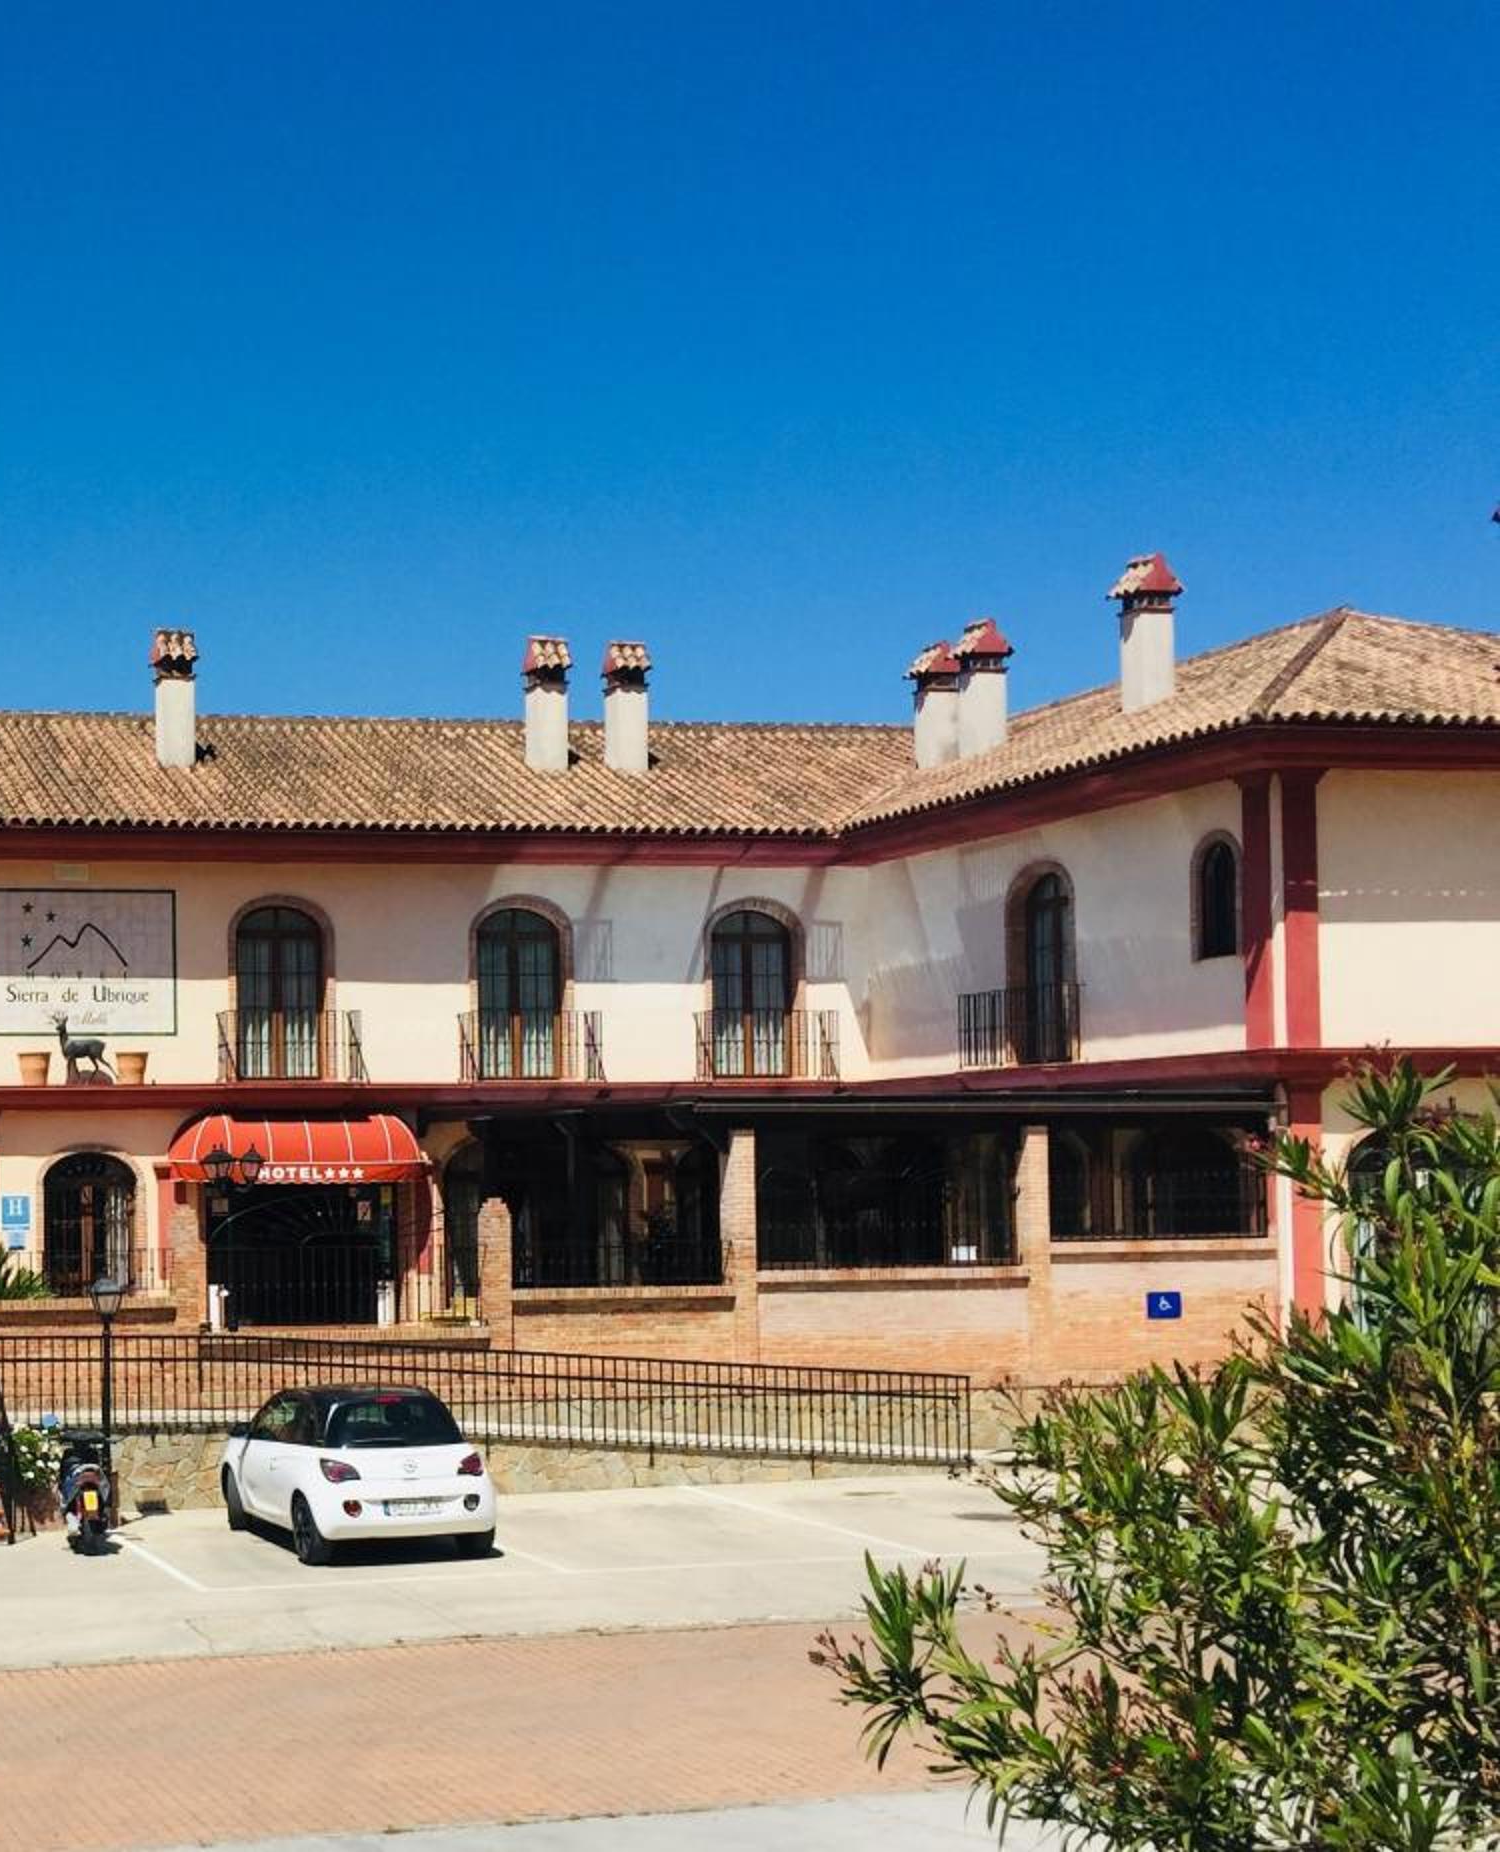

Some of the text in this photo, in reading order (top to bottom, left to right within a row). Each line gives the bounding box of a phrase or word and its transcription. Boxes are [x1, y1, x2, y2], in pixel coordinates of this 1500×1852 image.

[6, 984, 150, 1005] Sierra de Ubrique
[258, 1167, 322, 1179] HOTEL
[9, 1199, 22, 1216] H
